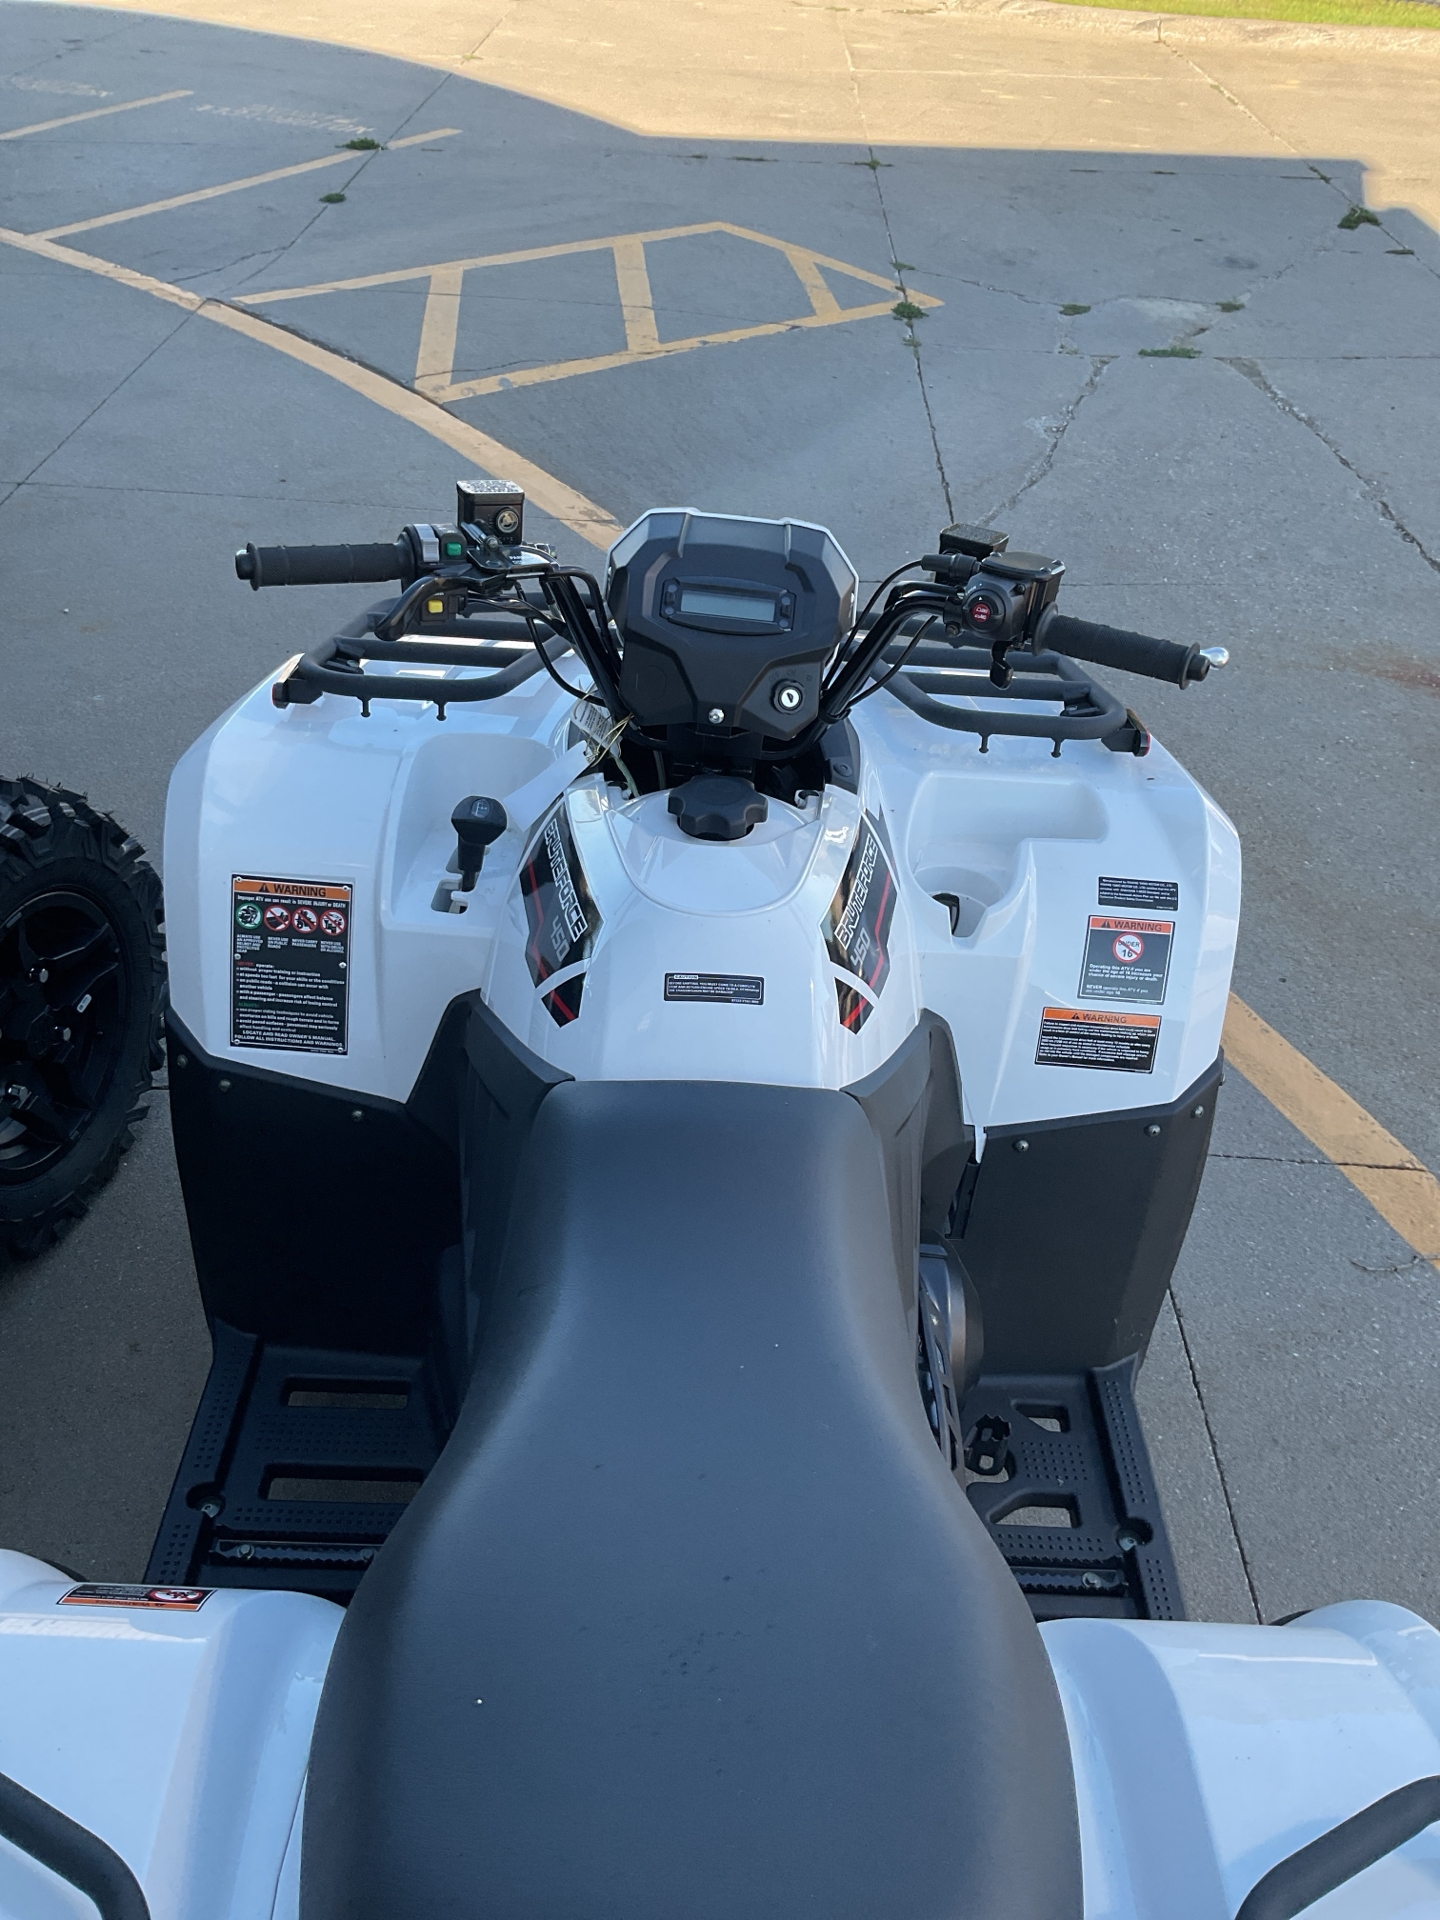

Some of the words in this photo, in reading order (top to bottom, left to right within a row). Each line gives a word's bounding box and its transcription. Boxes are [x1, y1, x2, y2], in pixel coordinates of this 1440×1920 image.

[274, 884, 327, 898] WARNING
[1114, 920, 1162, 932] WARNING
[550, 915, 570, 962] 450
[849, 926, 872, 968] 450
[1122, 949, 1133, 958] 16
[1082, 1013, 1126, 1023] WARNING
[266, 1037, 303, 1045] INSTRUCTIONS
